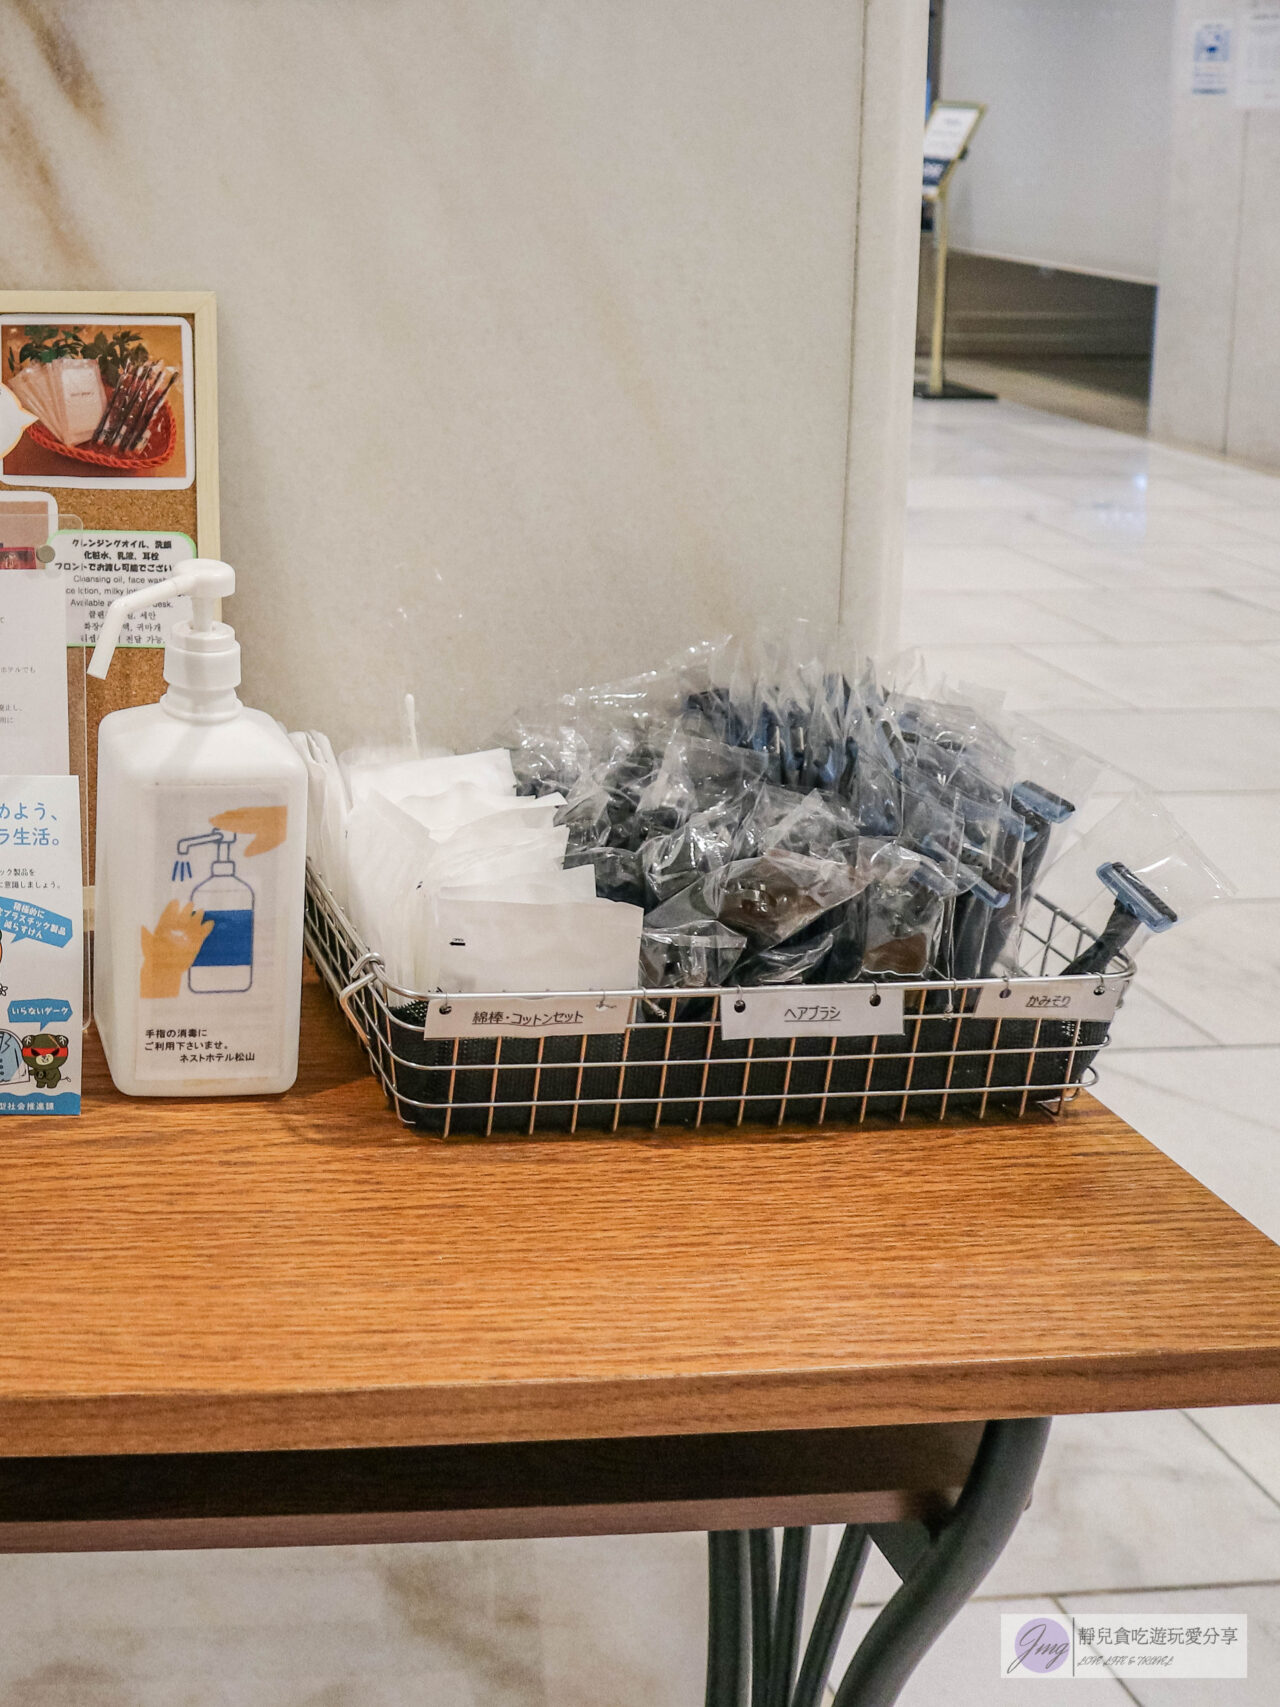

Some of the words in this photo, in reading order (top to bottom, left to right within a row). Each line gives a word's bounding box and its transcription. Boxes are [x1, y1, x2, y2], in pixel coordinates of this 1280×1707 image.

[113, 576, 125, 584] oil,
[128, 576, 146, 584] face
[104, 587, 124, 596] milky
[1025, 995, 1072, 1008] かみそり
[784, 1004, 841, 1020] ヘアブラシ
[471, 1010, 584, 1027] 綿棒・コットンセット
[145, 1028, 208, 1039] 手指の消毒に
[144, 1040, 230, 1051] ご利用下さいませ。
[179, 1052, 256, 1063] ネストホテル松山
